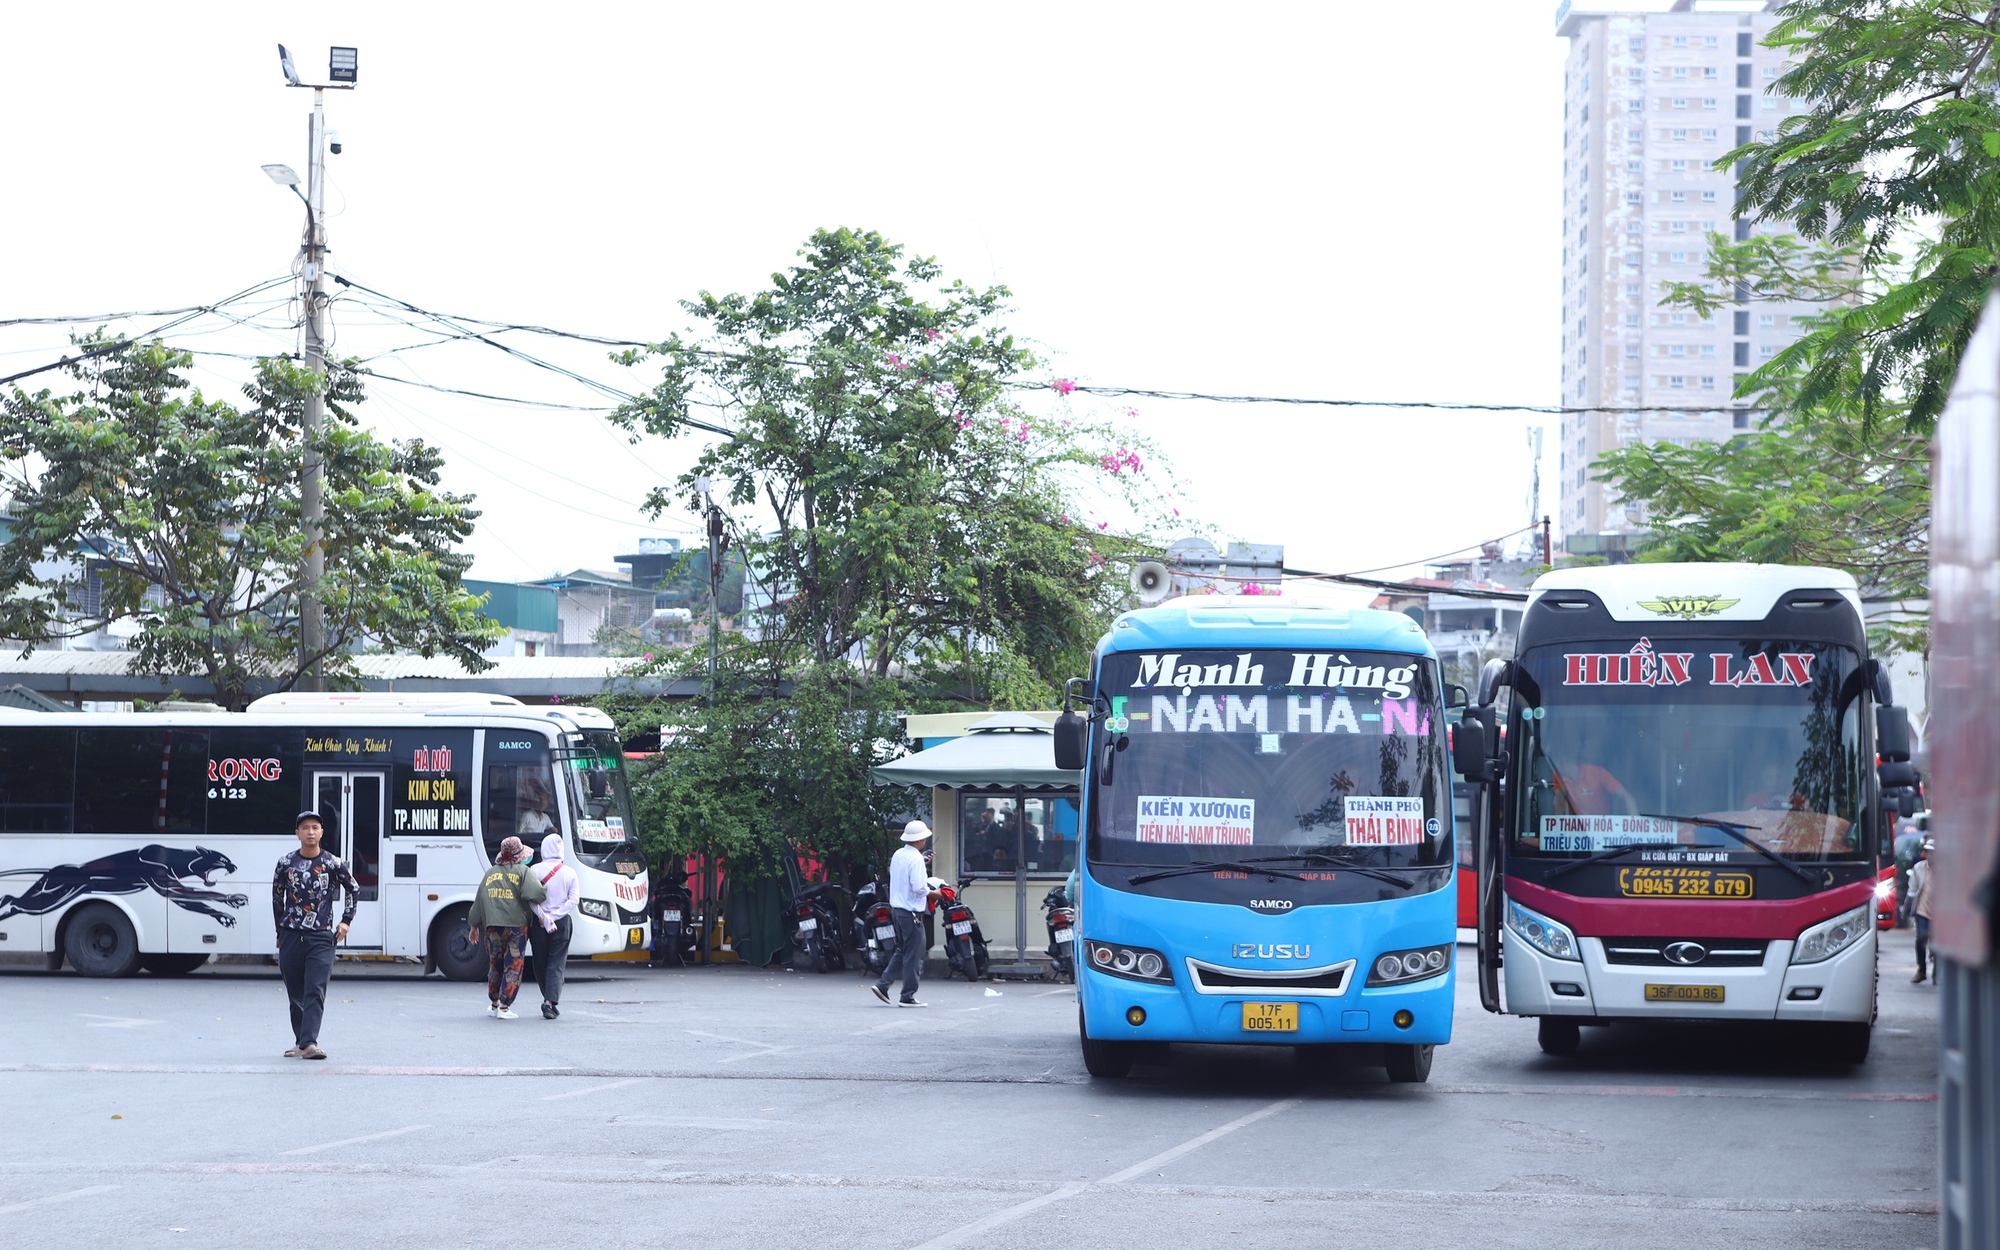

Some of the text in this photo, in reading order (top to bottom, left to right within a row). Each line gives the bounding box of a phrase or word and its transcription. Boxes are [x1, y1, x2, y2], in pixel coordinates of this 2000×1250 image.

[1668, 600, 1709, 612] VIP
[1562, 636, 1815, 688] HIỀN LAN
[1130, 653, 1418, 699] Mạnh Hùng
[304, 738, 323, 752] Kính
[324, 738, 343, 752] Chào
[345, 737, 360, 755] Quý
[362, 738, 387, 752] Khách
[499, 741, 532, 750] SAMCO
[414, 745, 452, 777] HÀ NỘI
[408, 778, 455, 801] KIM SƠN
[1142, 797, 1251, 820] KIẾN XƯƠNG
[1348, 797, 1421, 811] THÀNH PHỐ
[443, 805, 470, 831] BÌNH
[1545, 818, 1556, 831] TP
[1559, 818, 1591, 832] THANH
[1594, 816, 1613, 832] HÓA
[1622, 816, 1650, 832] ĐÔNG
[1139, 818, 1163, 843] TIỀN
[1347, 813, 1423, 844] THÁI BÌNH
[1574, 834, 1594, 850] SƠN
[1641, 852, 1651, 861] BX
[1687, 852, 1696, 861] BX
[1698, 851, 1714, 862] GIÁP
[1715, 851, 1729, 862] BÁT
[1633, 867, 1711, 877] Hotline
[1633, 878, 1746, 895] 0945 232 679
[1250, 899, 1293, 909] SAMCO
[1232, 943, 1311, 959] IZUSU
[1260, 1005, 1282, 1016] 17F
[1248, 1017, 1291, 1030] 005.11
